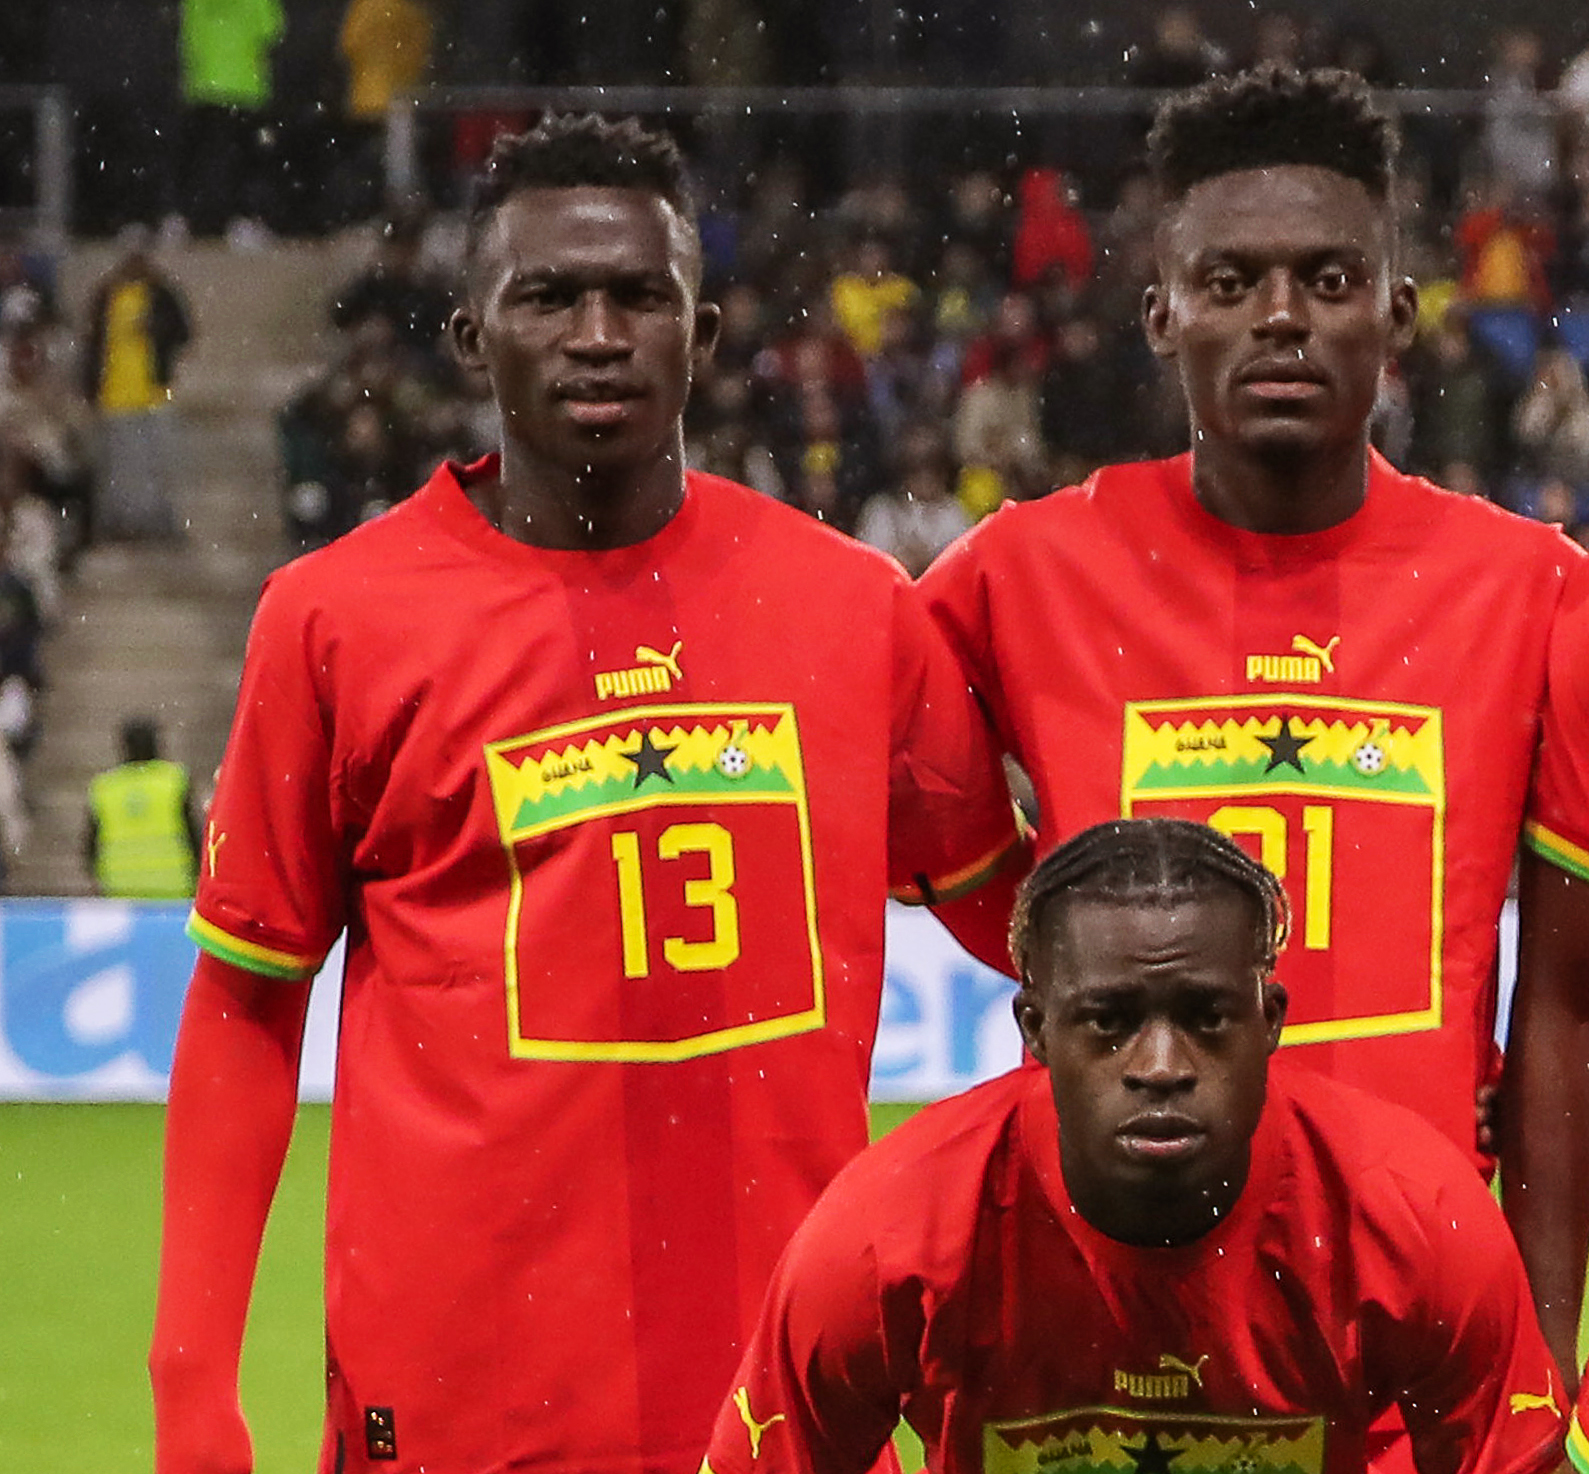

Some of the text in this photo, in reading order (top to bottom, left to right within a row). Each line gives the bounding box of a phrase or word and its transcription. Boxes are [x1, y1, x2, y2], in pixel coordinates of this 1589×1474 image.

[595, 666, 672, 700] PUMA
[1246, 655, 1322, 683] PUMA
[610, 821, 741, 980] 13
[1114, 1370, 1188, 1398] PUMA
